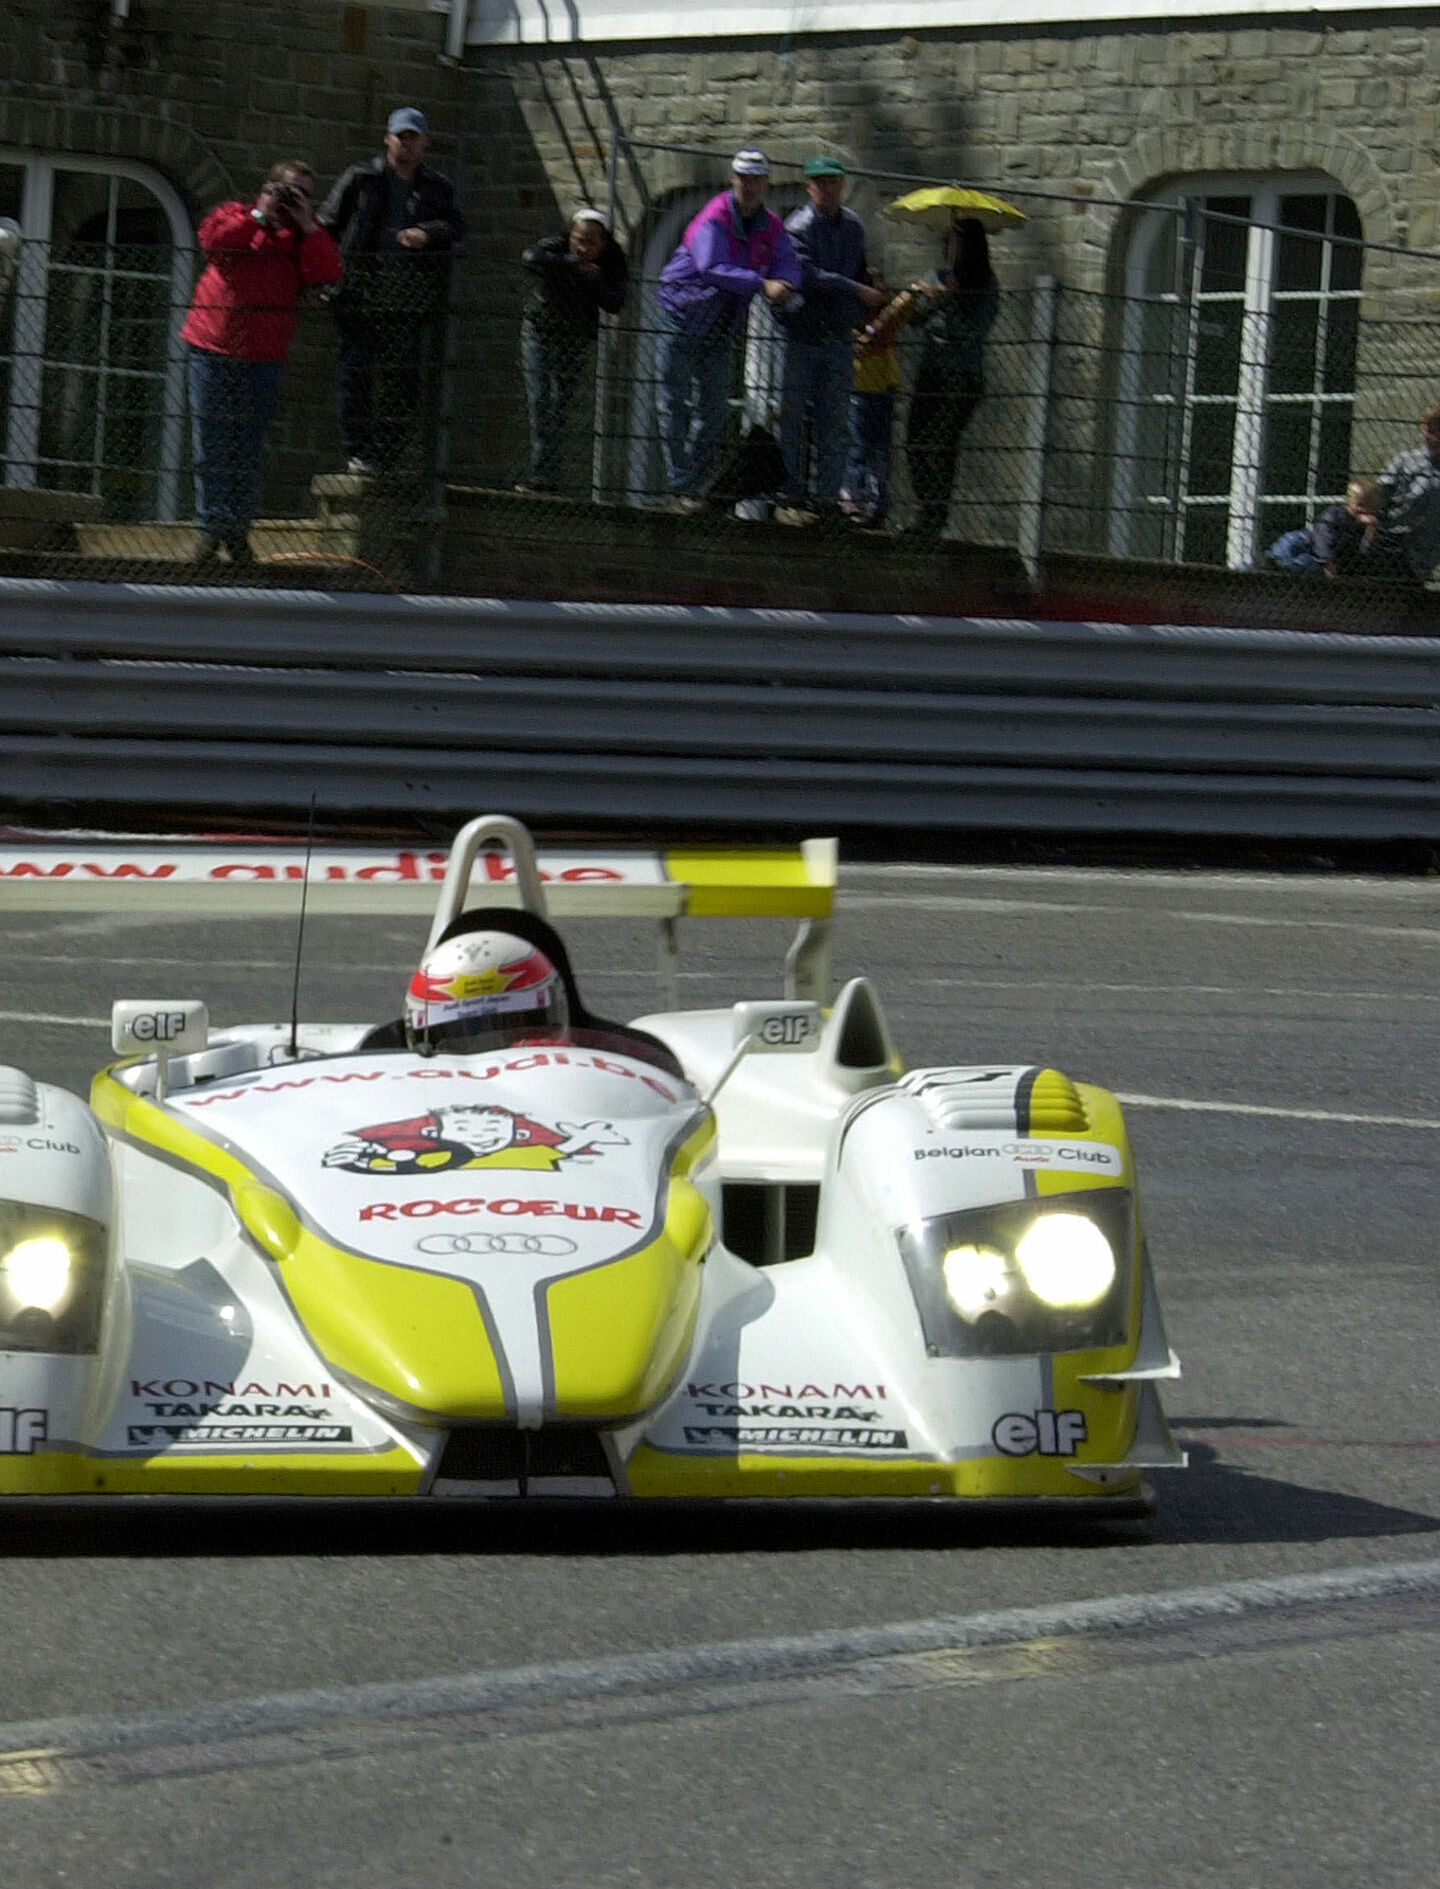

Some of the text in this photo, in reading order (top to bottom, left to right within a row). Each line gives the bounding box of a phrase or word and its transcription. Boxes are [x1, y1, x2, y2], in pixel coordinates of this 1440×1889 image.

[133, 1012, 185, 1040] elf
[763, 1014, 809, 1045] elf
[26, 1137, 81, 1155] Club
[913, 1144, 1001, 1161] Belgian
[1058, 1147, 1112, 1164] Club
[358, 1198, 643, 1229] ROCOEUR
[131, 1378, 331, 1399] KONAMI
[686, 1382, 888, 1400] KONAMI
[144, 1401, 312, 1418] TAKARA
[695, 1403, 864, 1420] TAKARA
[182, 1426, 342, 1441] MICHELIN
[737, 1427, 896, 1446] MICHELIN
[991, 1408, 1088, 1457] elf
